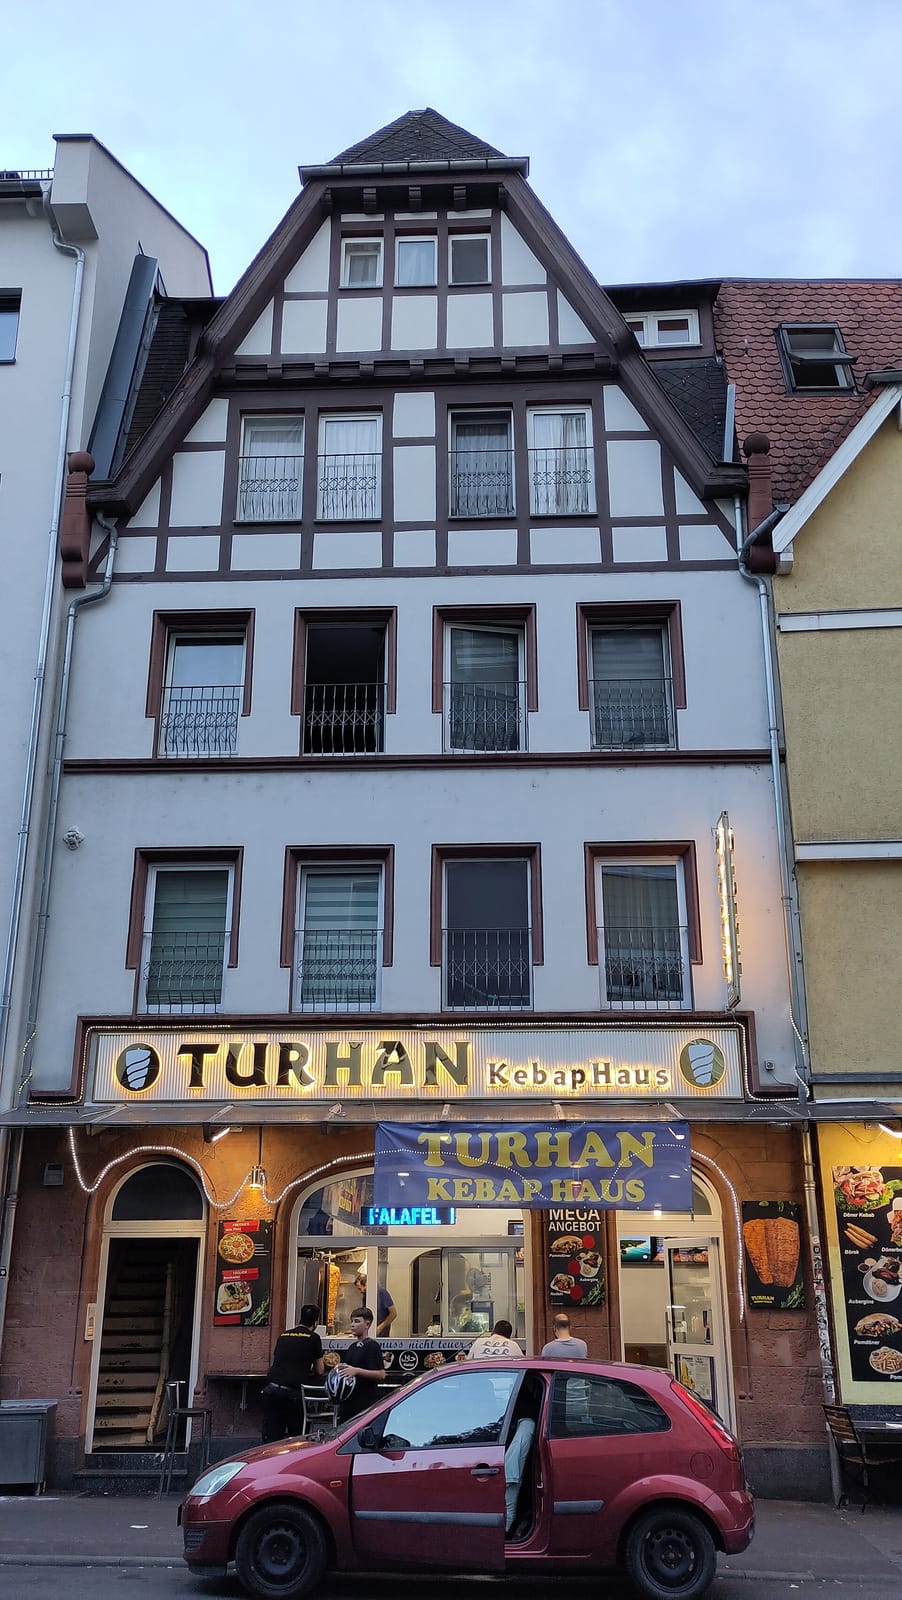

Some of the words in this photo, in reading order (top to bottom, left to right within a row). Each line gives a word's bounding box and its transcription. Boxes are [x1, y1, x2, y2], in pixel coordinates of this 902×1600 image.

[177, 1040, 472, 1088] TURHAN
[417, 1131, 657, 1168] TURHAN
[426, 1178, 544, 1201] KEBAP
[550, 1179, 646, 1203] HAUS
[369, 1207, 442, 1225] FALAFEL
[549, 1209, 600, 1221] MEGA
[548, 1221, 602, 1232] ANGEBOT
[408, 1339, 434, 1349] nicht
[438, 1340, 464, 1349] teuer
